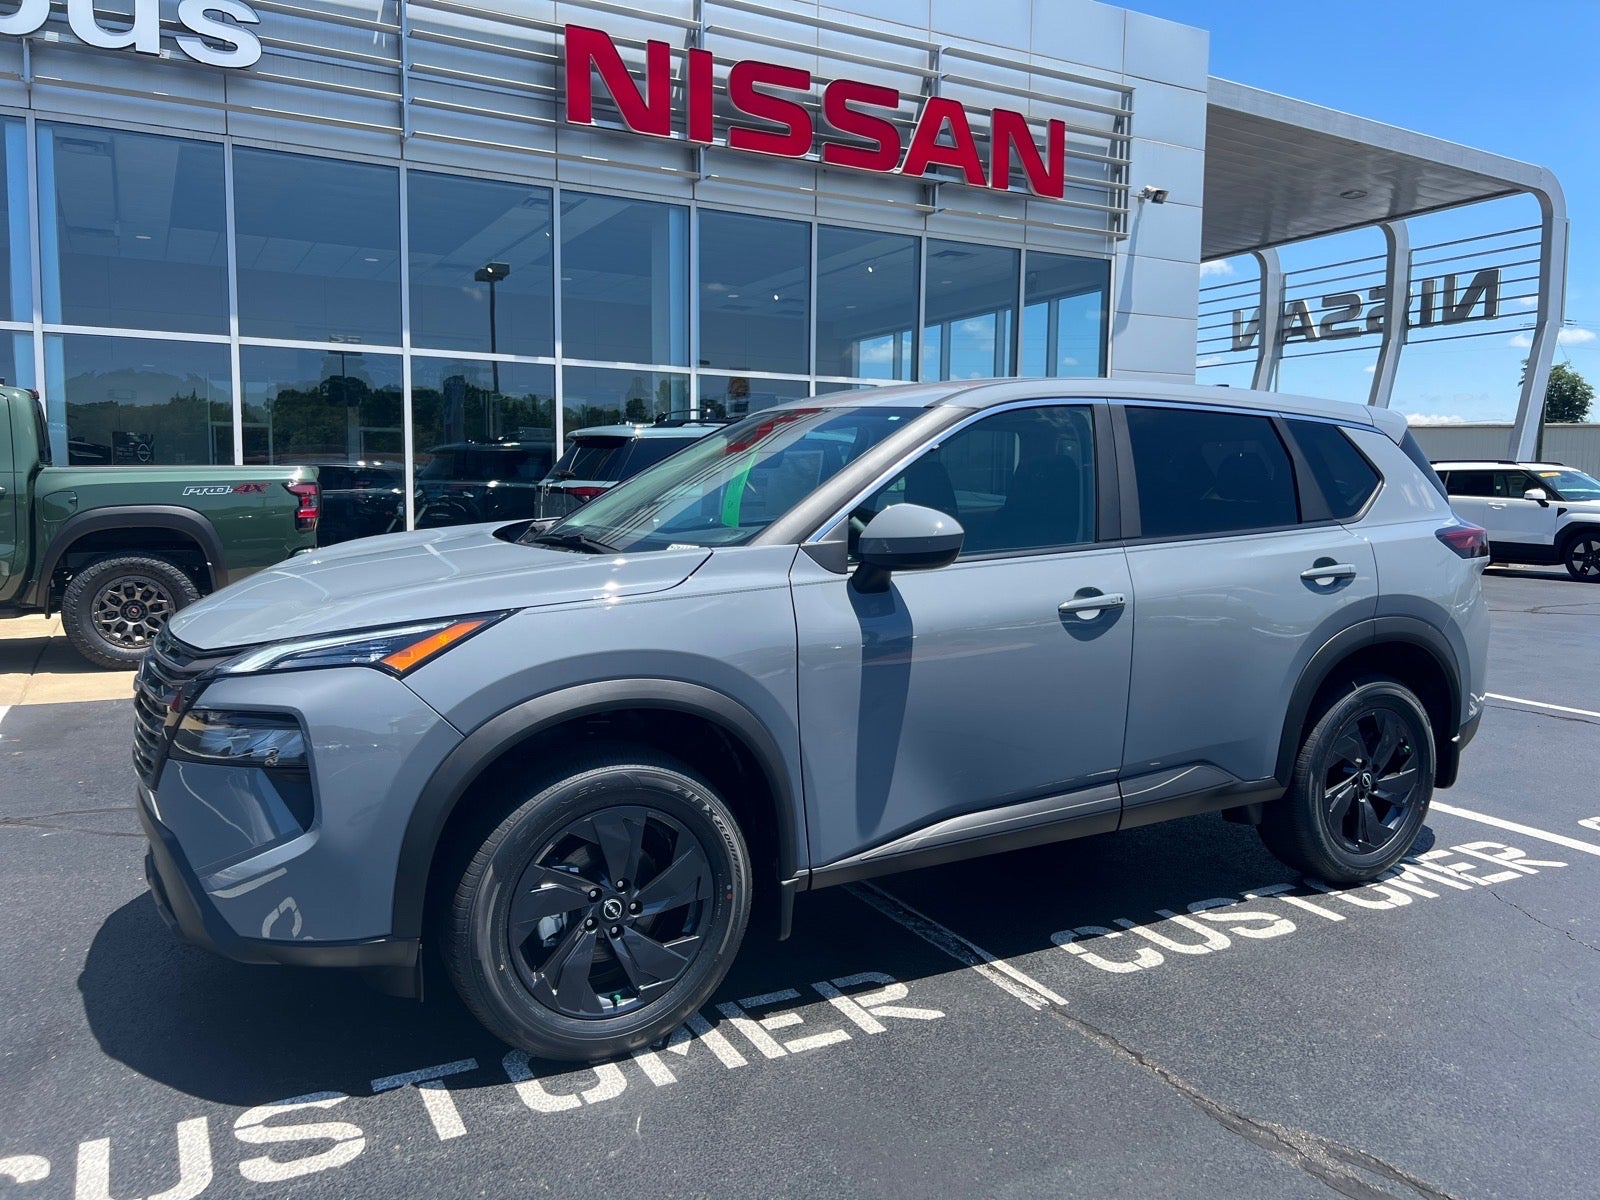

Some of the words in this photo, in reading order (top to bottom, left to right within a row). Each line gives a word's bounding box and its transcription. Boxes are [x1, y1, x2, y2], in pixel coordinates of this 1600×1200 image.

[0, 0, 262, 68] us
[564, 23, 1066, 200] NISSAN
[1050, 840, 1569, 974] CUSTOMER
[0, 970, 946, 1200] USTOMER
